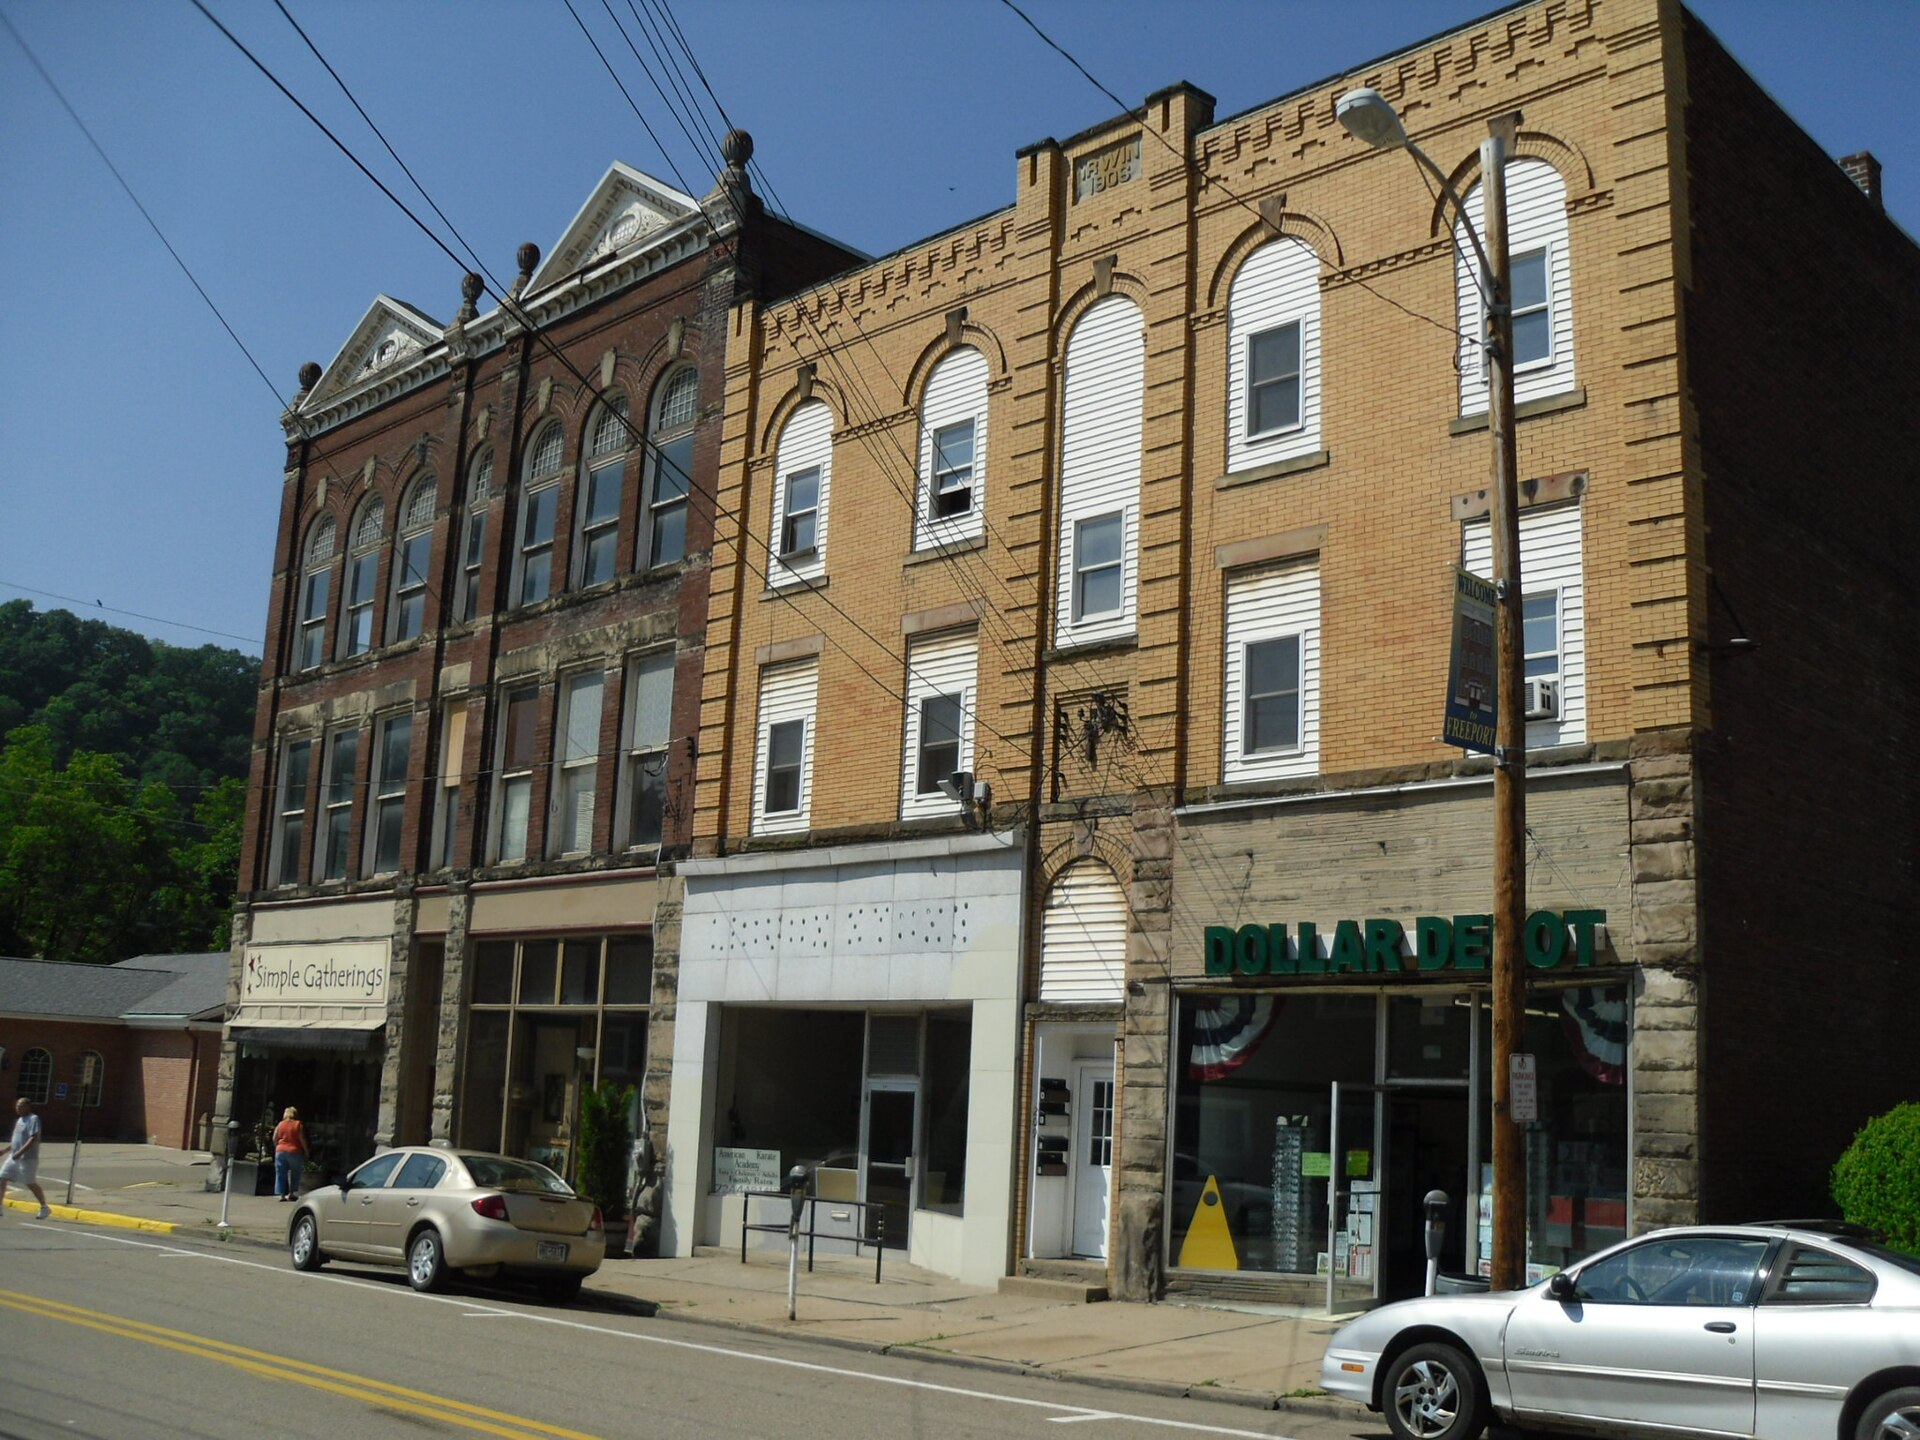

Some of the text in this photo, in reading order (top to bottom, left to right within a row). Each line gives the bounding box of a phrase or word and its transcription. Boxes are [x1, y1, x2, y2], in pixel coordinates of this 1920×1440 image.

[1457, 574, 1497, 608] WELCOME
[1446, 716, 1496, 746] FREEPORT
[1204, 909, 1607, 976] DOLLAR DEOT
[256, 957, 383, 997] Simple Gatherings
